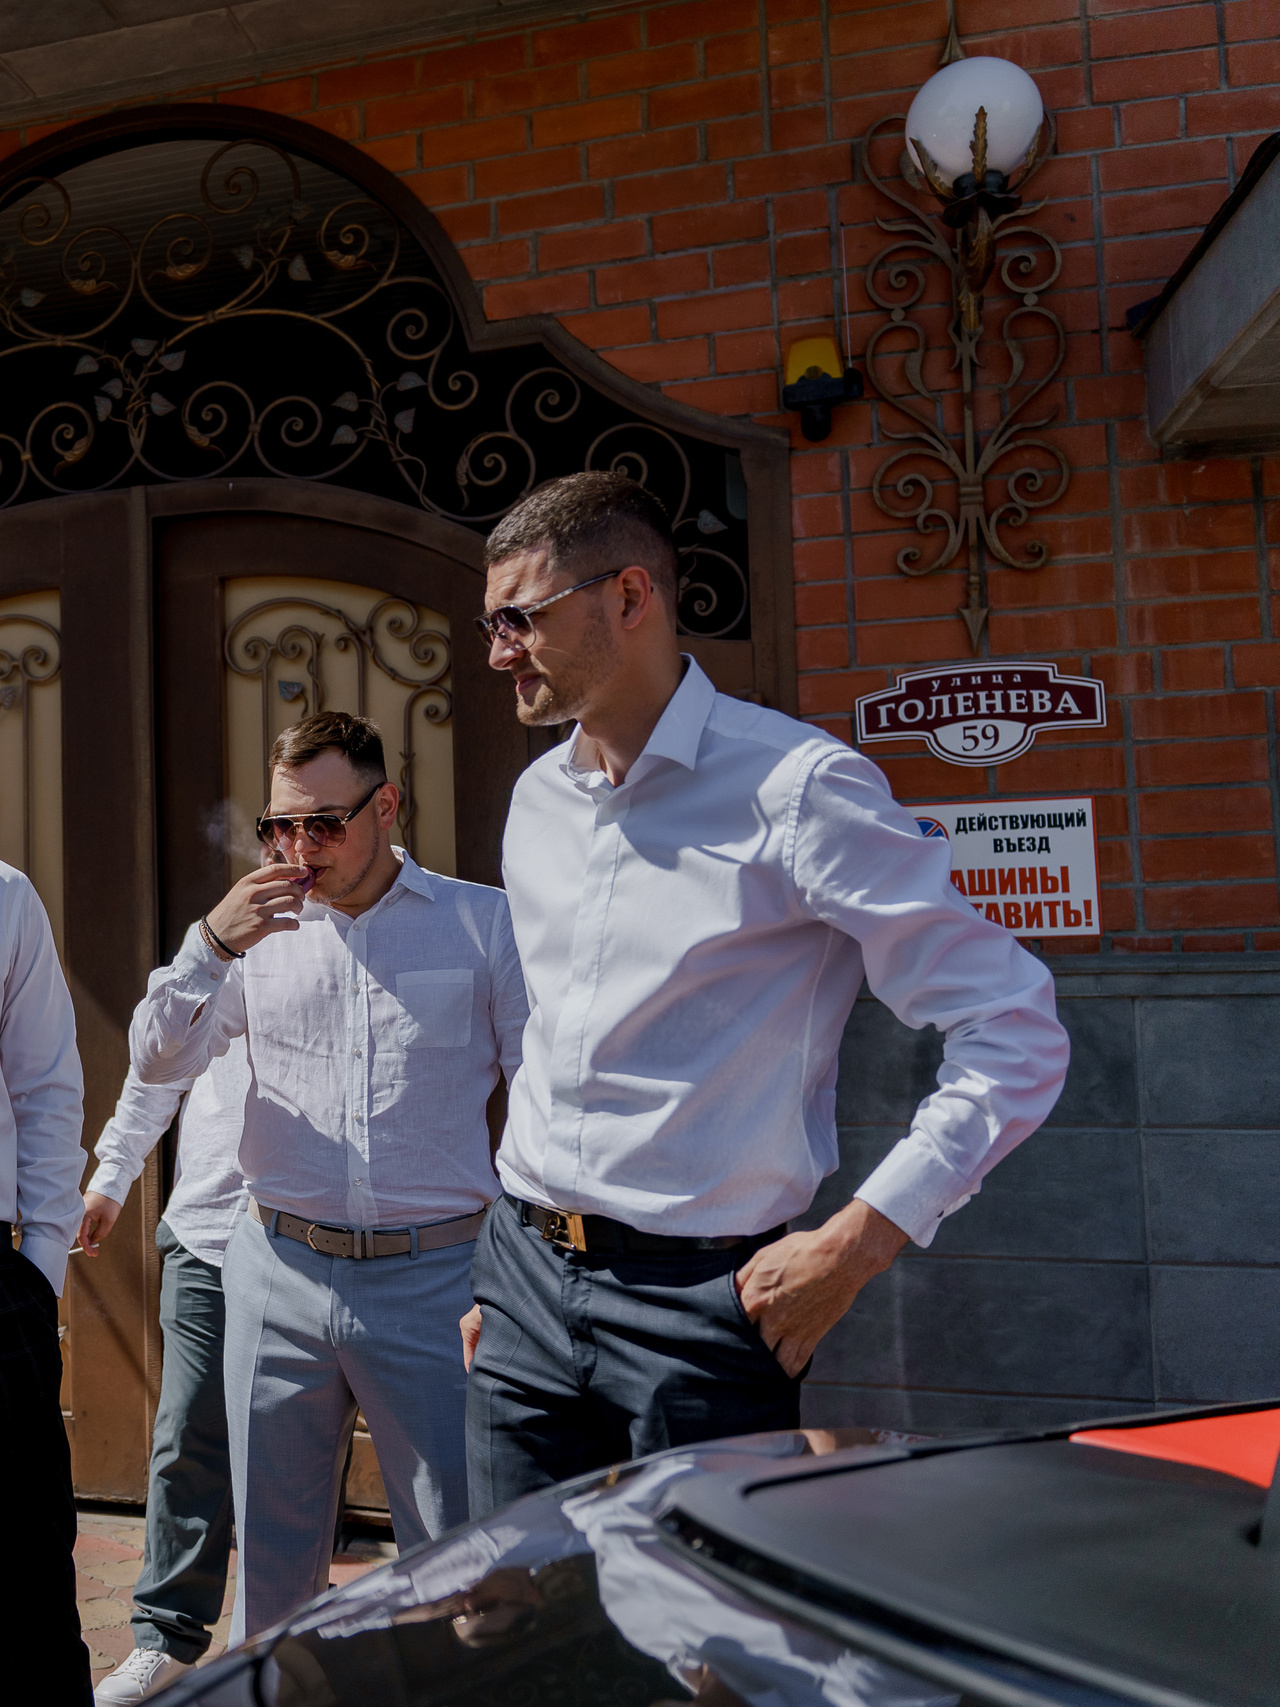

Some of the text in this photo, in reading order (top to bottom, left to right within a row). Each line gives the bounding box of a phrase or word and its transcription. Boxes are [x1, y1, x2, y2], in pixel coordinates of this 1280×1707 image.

[931, 674, 1022, 692] улица
[877, 690, 1082, 728] ГОЛЕНЕВА
[961, 724, 1000, 751] 59
[955, 808, 1087, 835] ДЕЙСТВУЮЩИЙ
[993, 836, 1051, 854] ВЪЕЗД
[950, 866, 1070, 896] АШИНЫ
[970, 899, 1093, 929] АВИТЬ!
